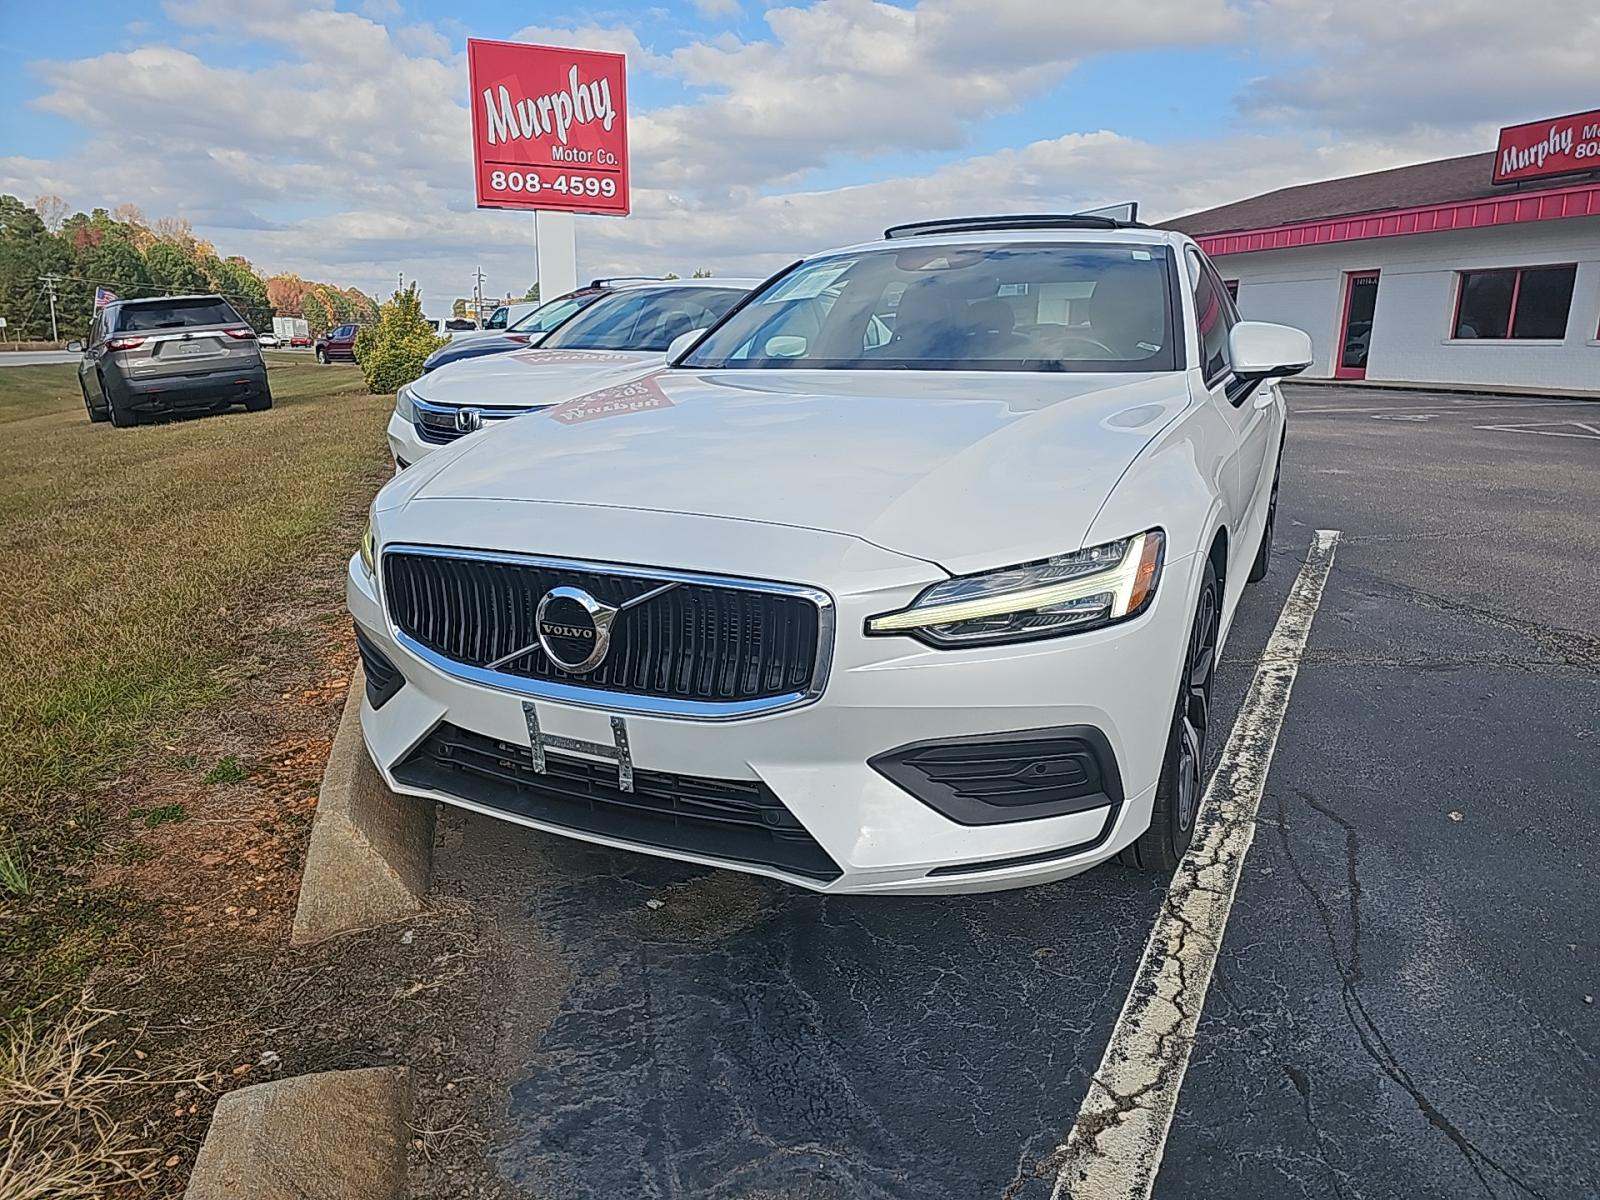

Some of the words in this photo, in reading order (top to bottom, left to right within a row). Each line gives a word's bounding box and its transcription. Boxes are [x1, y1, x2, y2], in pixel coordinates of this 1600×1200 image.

[482, 64, 616, 145] Murphy
[551, 146, 593, 163] Motor
[596, 148, 618, 165] Co.
[1500, 125, 1574, 176] Murphy
[490, 170, 616, 198] 808-4599
[542, 624, 593, 638] VOLVO
